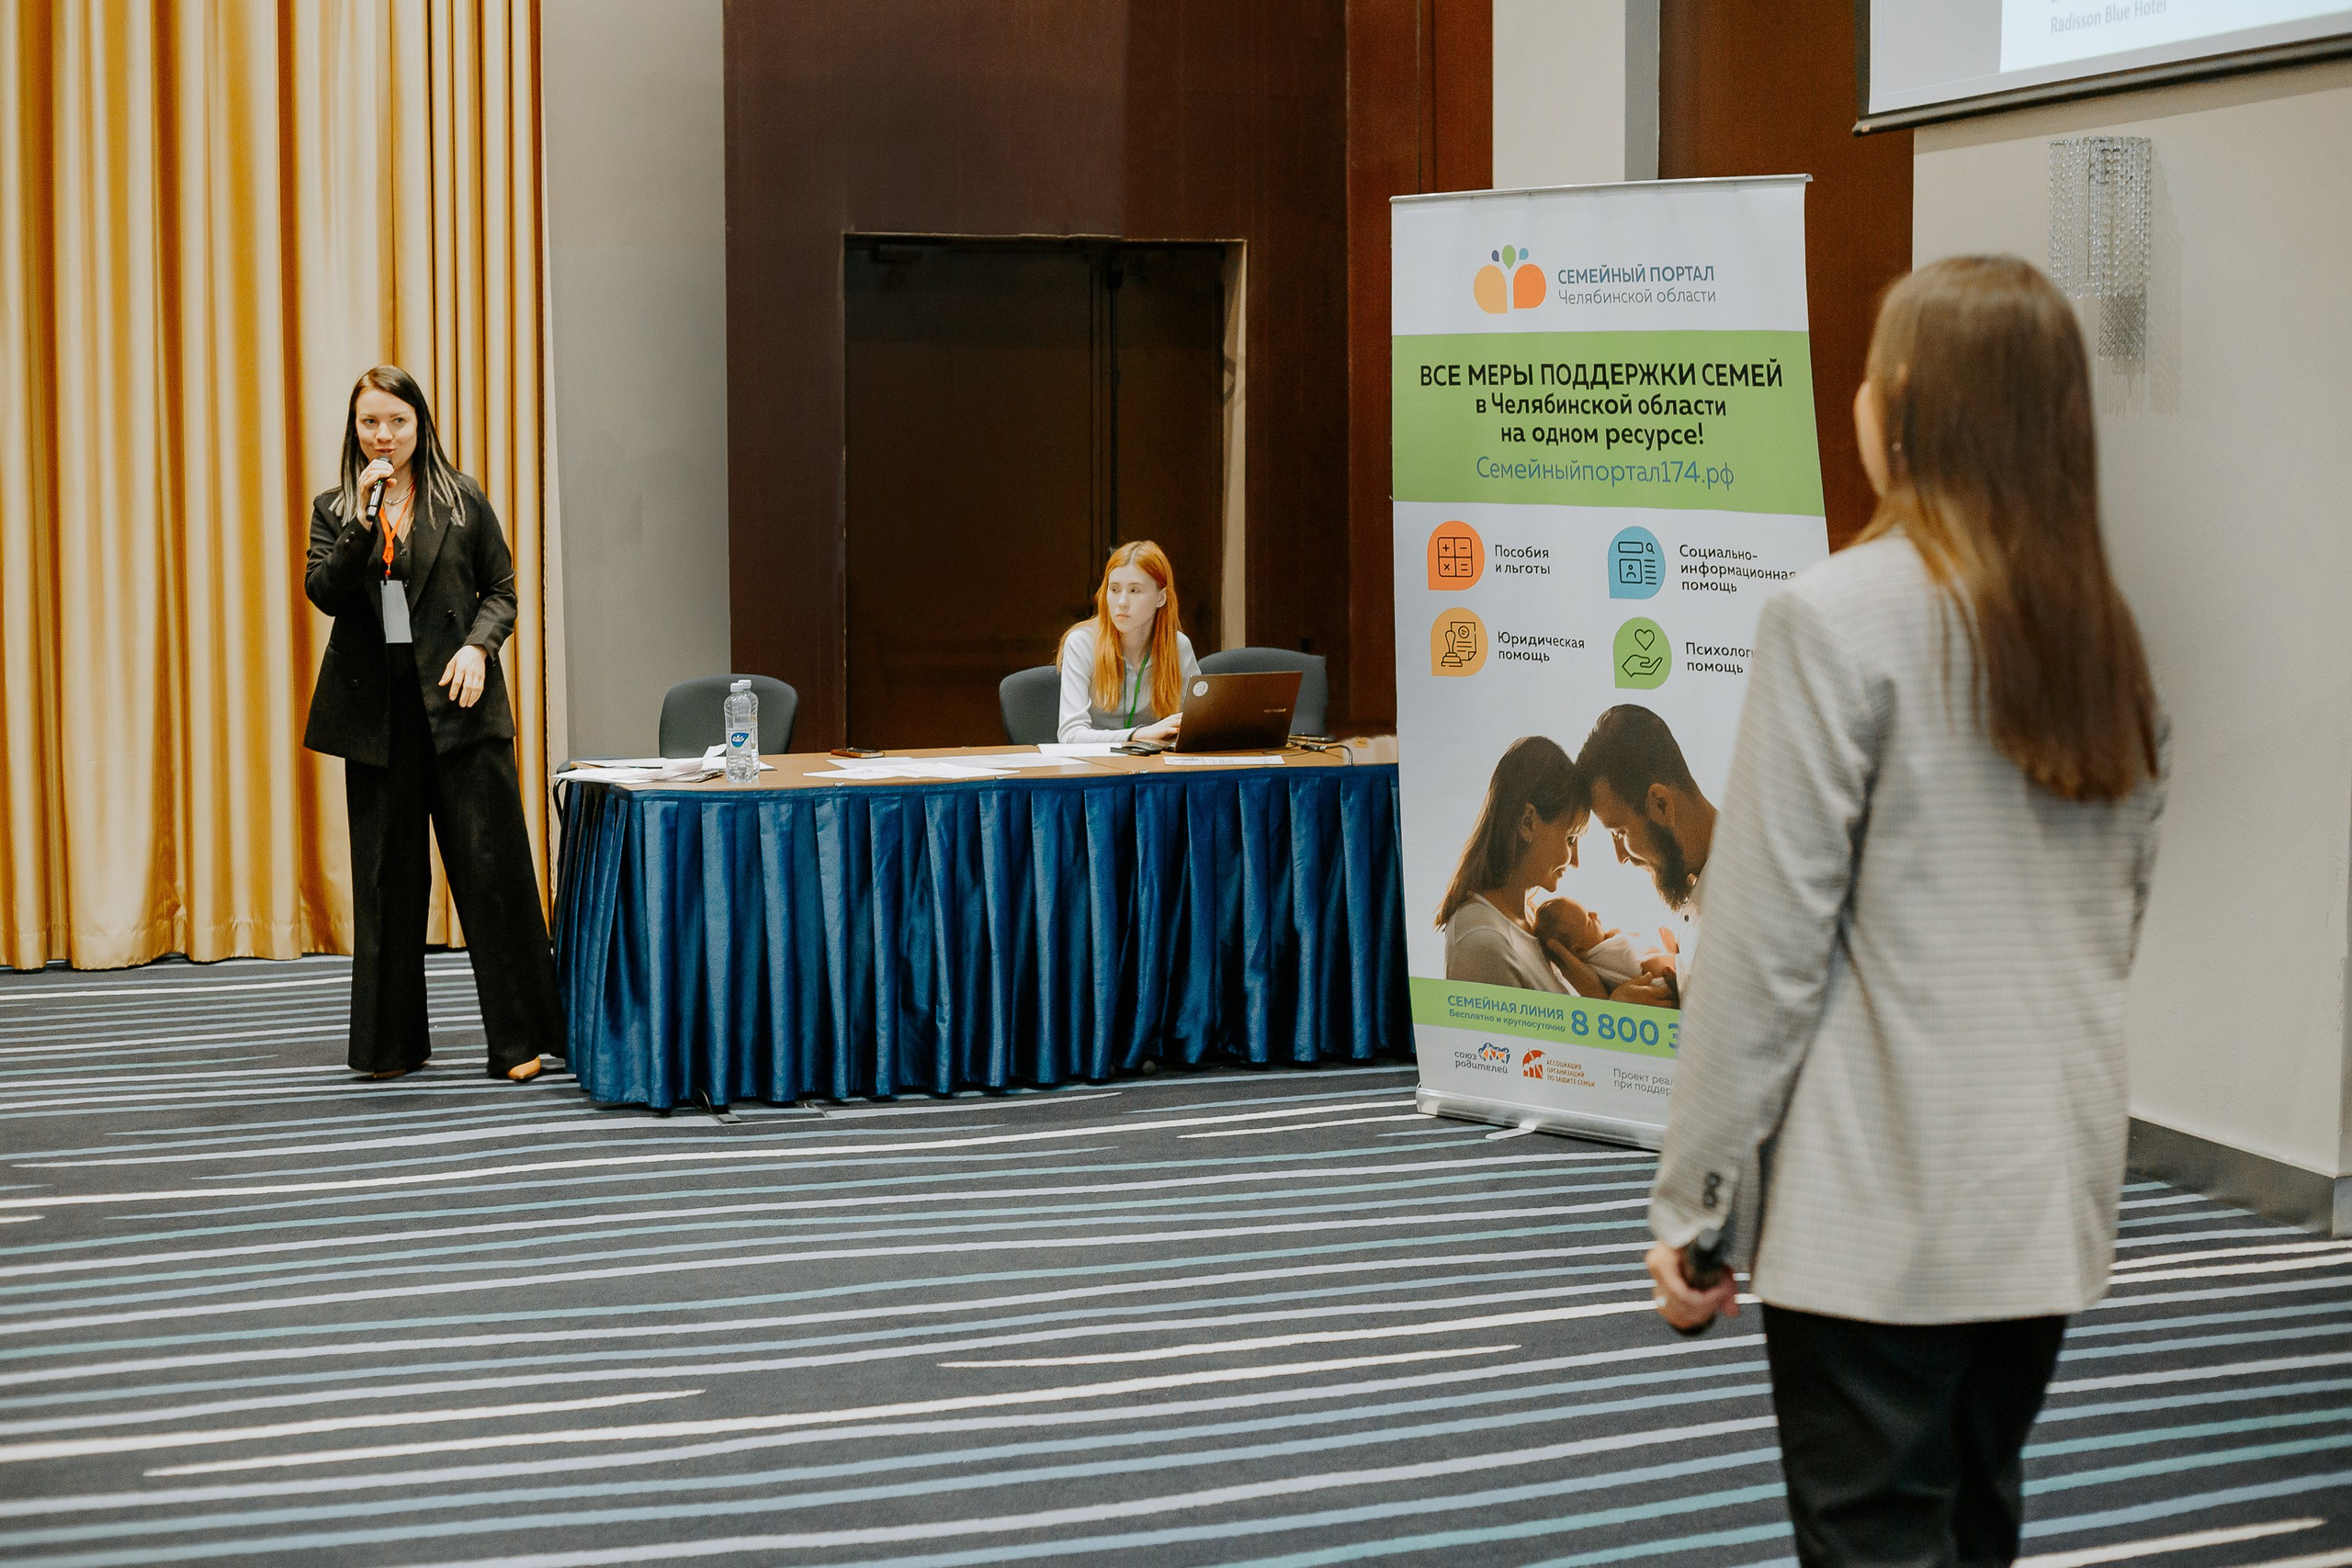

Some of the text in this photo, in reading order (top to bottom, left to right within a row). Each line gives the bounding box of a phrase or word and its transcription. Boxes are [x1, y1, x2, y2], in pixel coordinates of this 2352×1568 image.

[2051, 0, 2166, 34] Radisson Blue Hotel
[1557, 265, 1715, 285] СЕМЕЙНЫЙ ПОРТАЛ
[1558, 285, 1716, 306] Челябинской области
[1420, 358, 1783, 389] ВСЕ МЕРЫ ПОДДЕРЖКИ СЕМЕЙ
[1476, 392, 1727, 416] в Челябинской области
[1500, 423, 1704, 451] на одном ресурсе!
[1476, 457, 1735, 491] Семейныйпортал174.рф
[1494, 545, 1550, 559] Пособия
[1679, 544, 1758, 560] Социально-
[1495, 563, 1552, 575] и льготы
[1681, 581, 1737, 594] помощь
[1498, 631, 1586, 649] Юридическая
[1498, 649, 1551, 663] помощь
[1685, 642, 1754, 659] Психолог
[1687, 661, 1744, 675] помощь
[1447, 995, 1565, 1021] СЕМЕЙНАЯ ЛИНИЯ
[1449, 1009, 1495, 1022] Бесплатно
[1503, 1018, 1566, 1032] круглосуточно
[1571, 1010, 1589, 1037] 8
[1598, 1013, 1659, 1046] 800
[1454, 1051, 1477, 1060] союз
[1455, 1060, 1509, 1074] родителей
[1613, 1068, 1673, 1086] Проект реа
[1614, 1080, 1633, 1090] при
